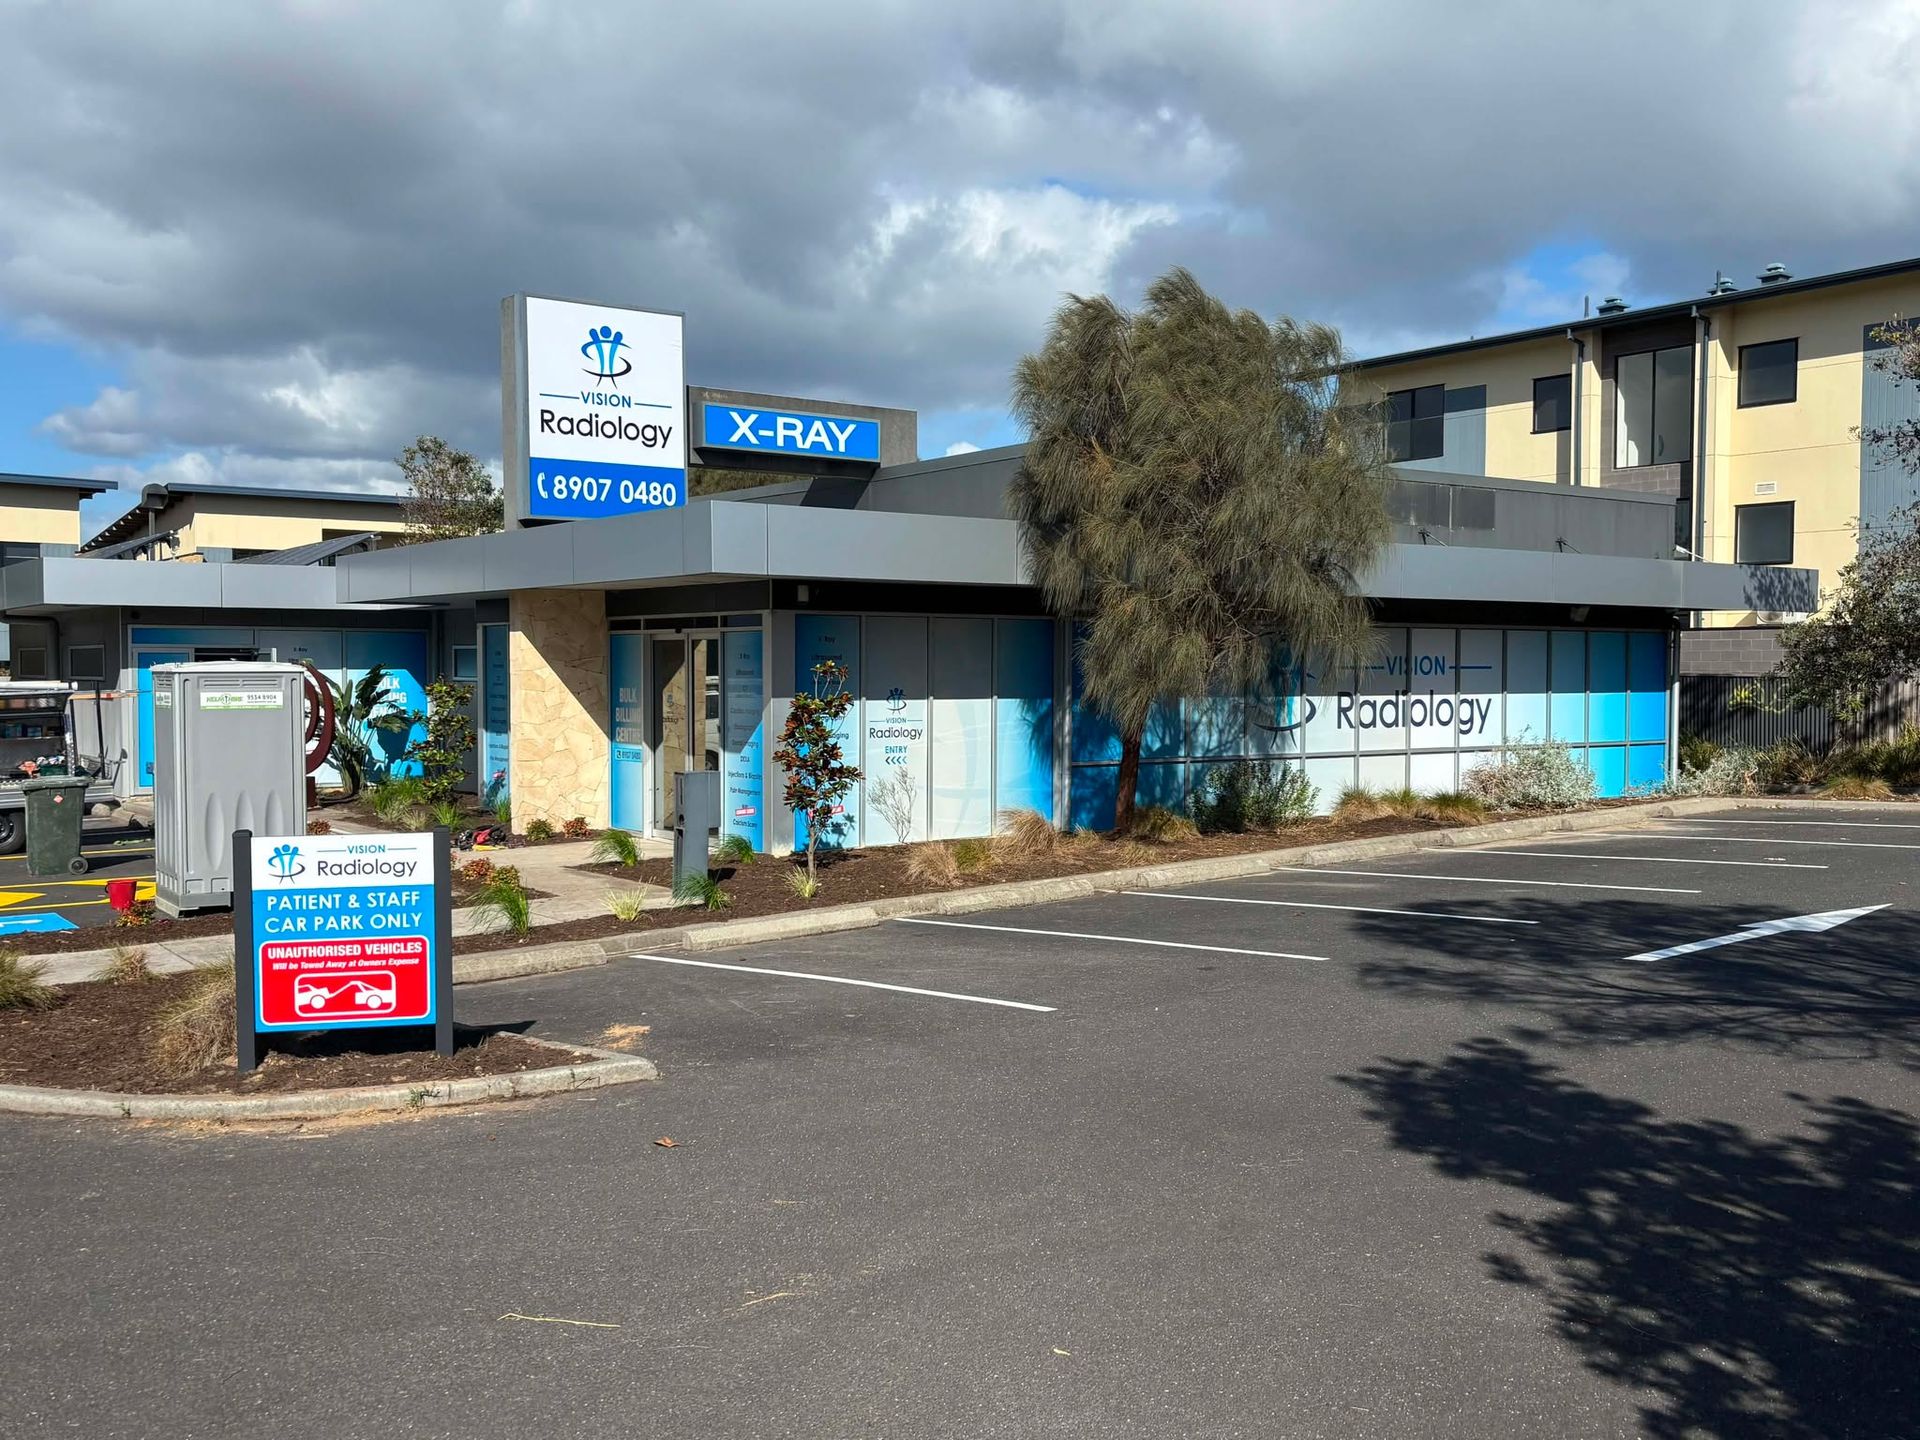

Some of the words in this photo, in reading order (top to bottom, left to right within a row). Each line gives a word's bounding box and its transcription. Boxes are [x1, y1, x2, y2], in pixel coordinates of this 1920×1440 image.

[580, 390, 632, 409] VISION
[539, 409, 672, 449] Radiology
[728, 411, 857, 453] X-RAY
[553, 474, 612, 503] 8907
[619, 478, 677, 507] 0480
[1336, 689, 1492, 735] Radiology
[869, 727, 923, 740] Radiology
[885, 745, 908, 754] ENTRY
[347, 844, 386, 855] VISION
[317, 859, 418, 878] Radiology
[267, 893, 342, 912] PATIENT
[348, 894, 361, 909] &
[367, 891, 421, 908] STAFF
[264, 916, 306, 933] CAR
[314, 915, 364, 931] PARK
[370, 912, 423, 929] ONLY
[267, 944, 361, 959] UNAUTHORISED
[365, 941, 423, 955] VEHICLES
[272, 962, 287, 970] Will
[288, 962, 298, 970] be
[300, 960, 325, 969] Towed
[326, 959, 347, 969] Away
[348, 959, 356, 968] at
[358, 958, 386, 968] Owners
[388, 957, 420, 967] Expense
